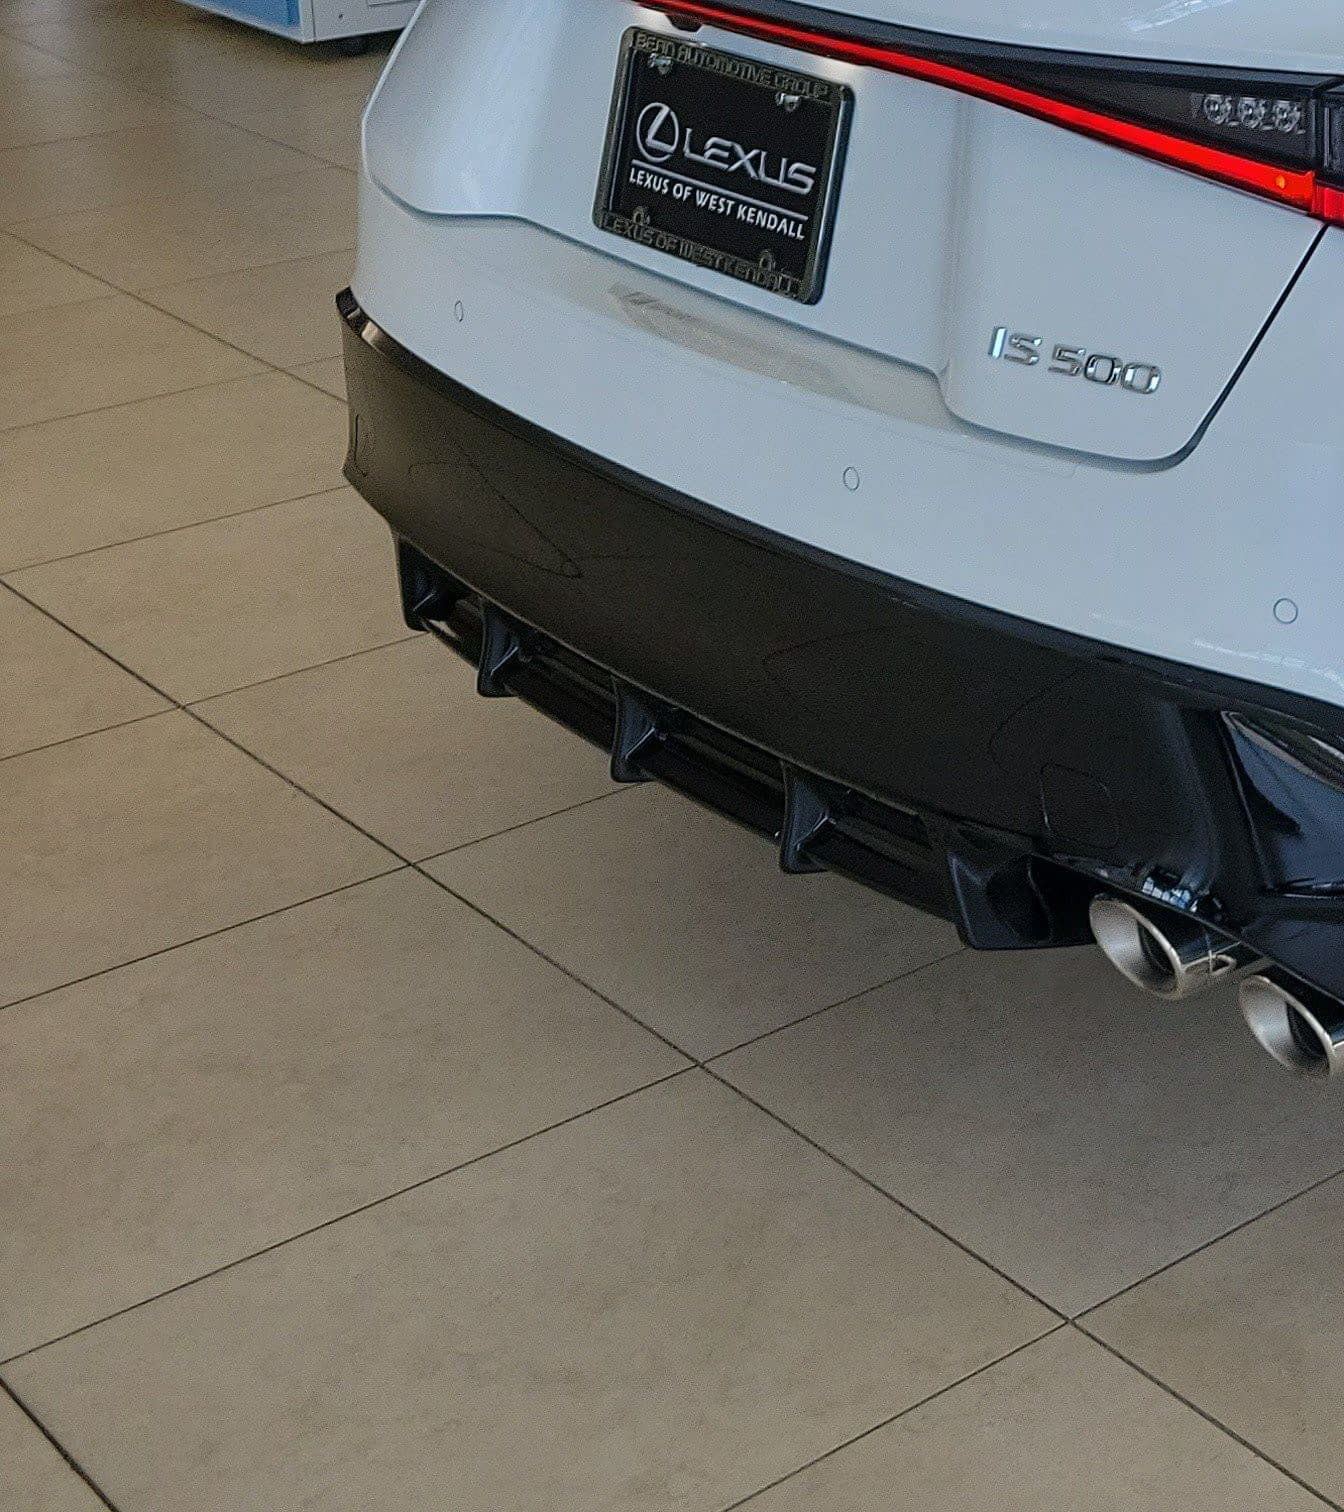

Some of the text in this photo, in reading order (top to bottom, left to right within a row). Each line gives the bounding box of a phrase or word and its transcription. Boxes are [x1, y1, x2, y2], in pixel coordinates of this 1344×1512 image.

[677, 44, 773, 86] AUTOMOTIVE
[774, 74, 828, 97] GROUP
[683, 128, 816, 195] LEXUS
[629, 168, 806, 241] LEXUS OF WEST KENDALL
[604, 214, 652, 244] LEXUS
[655, 234, 676, 251] OF
[679, 239, 722, 269] WEST
[988, 327, 1161, 395] IS 500
